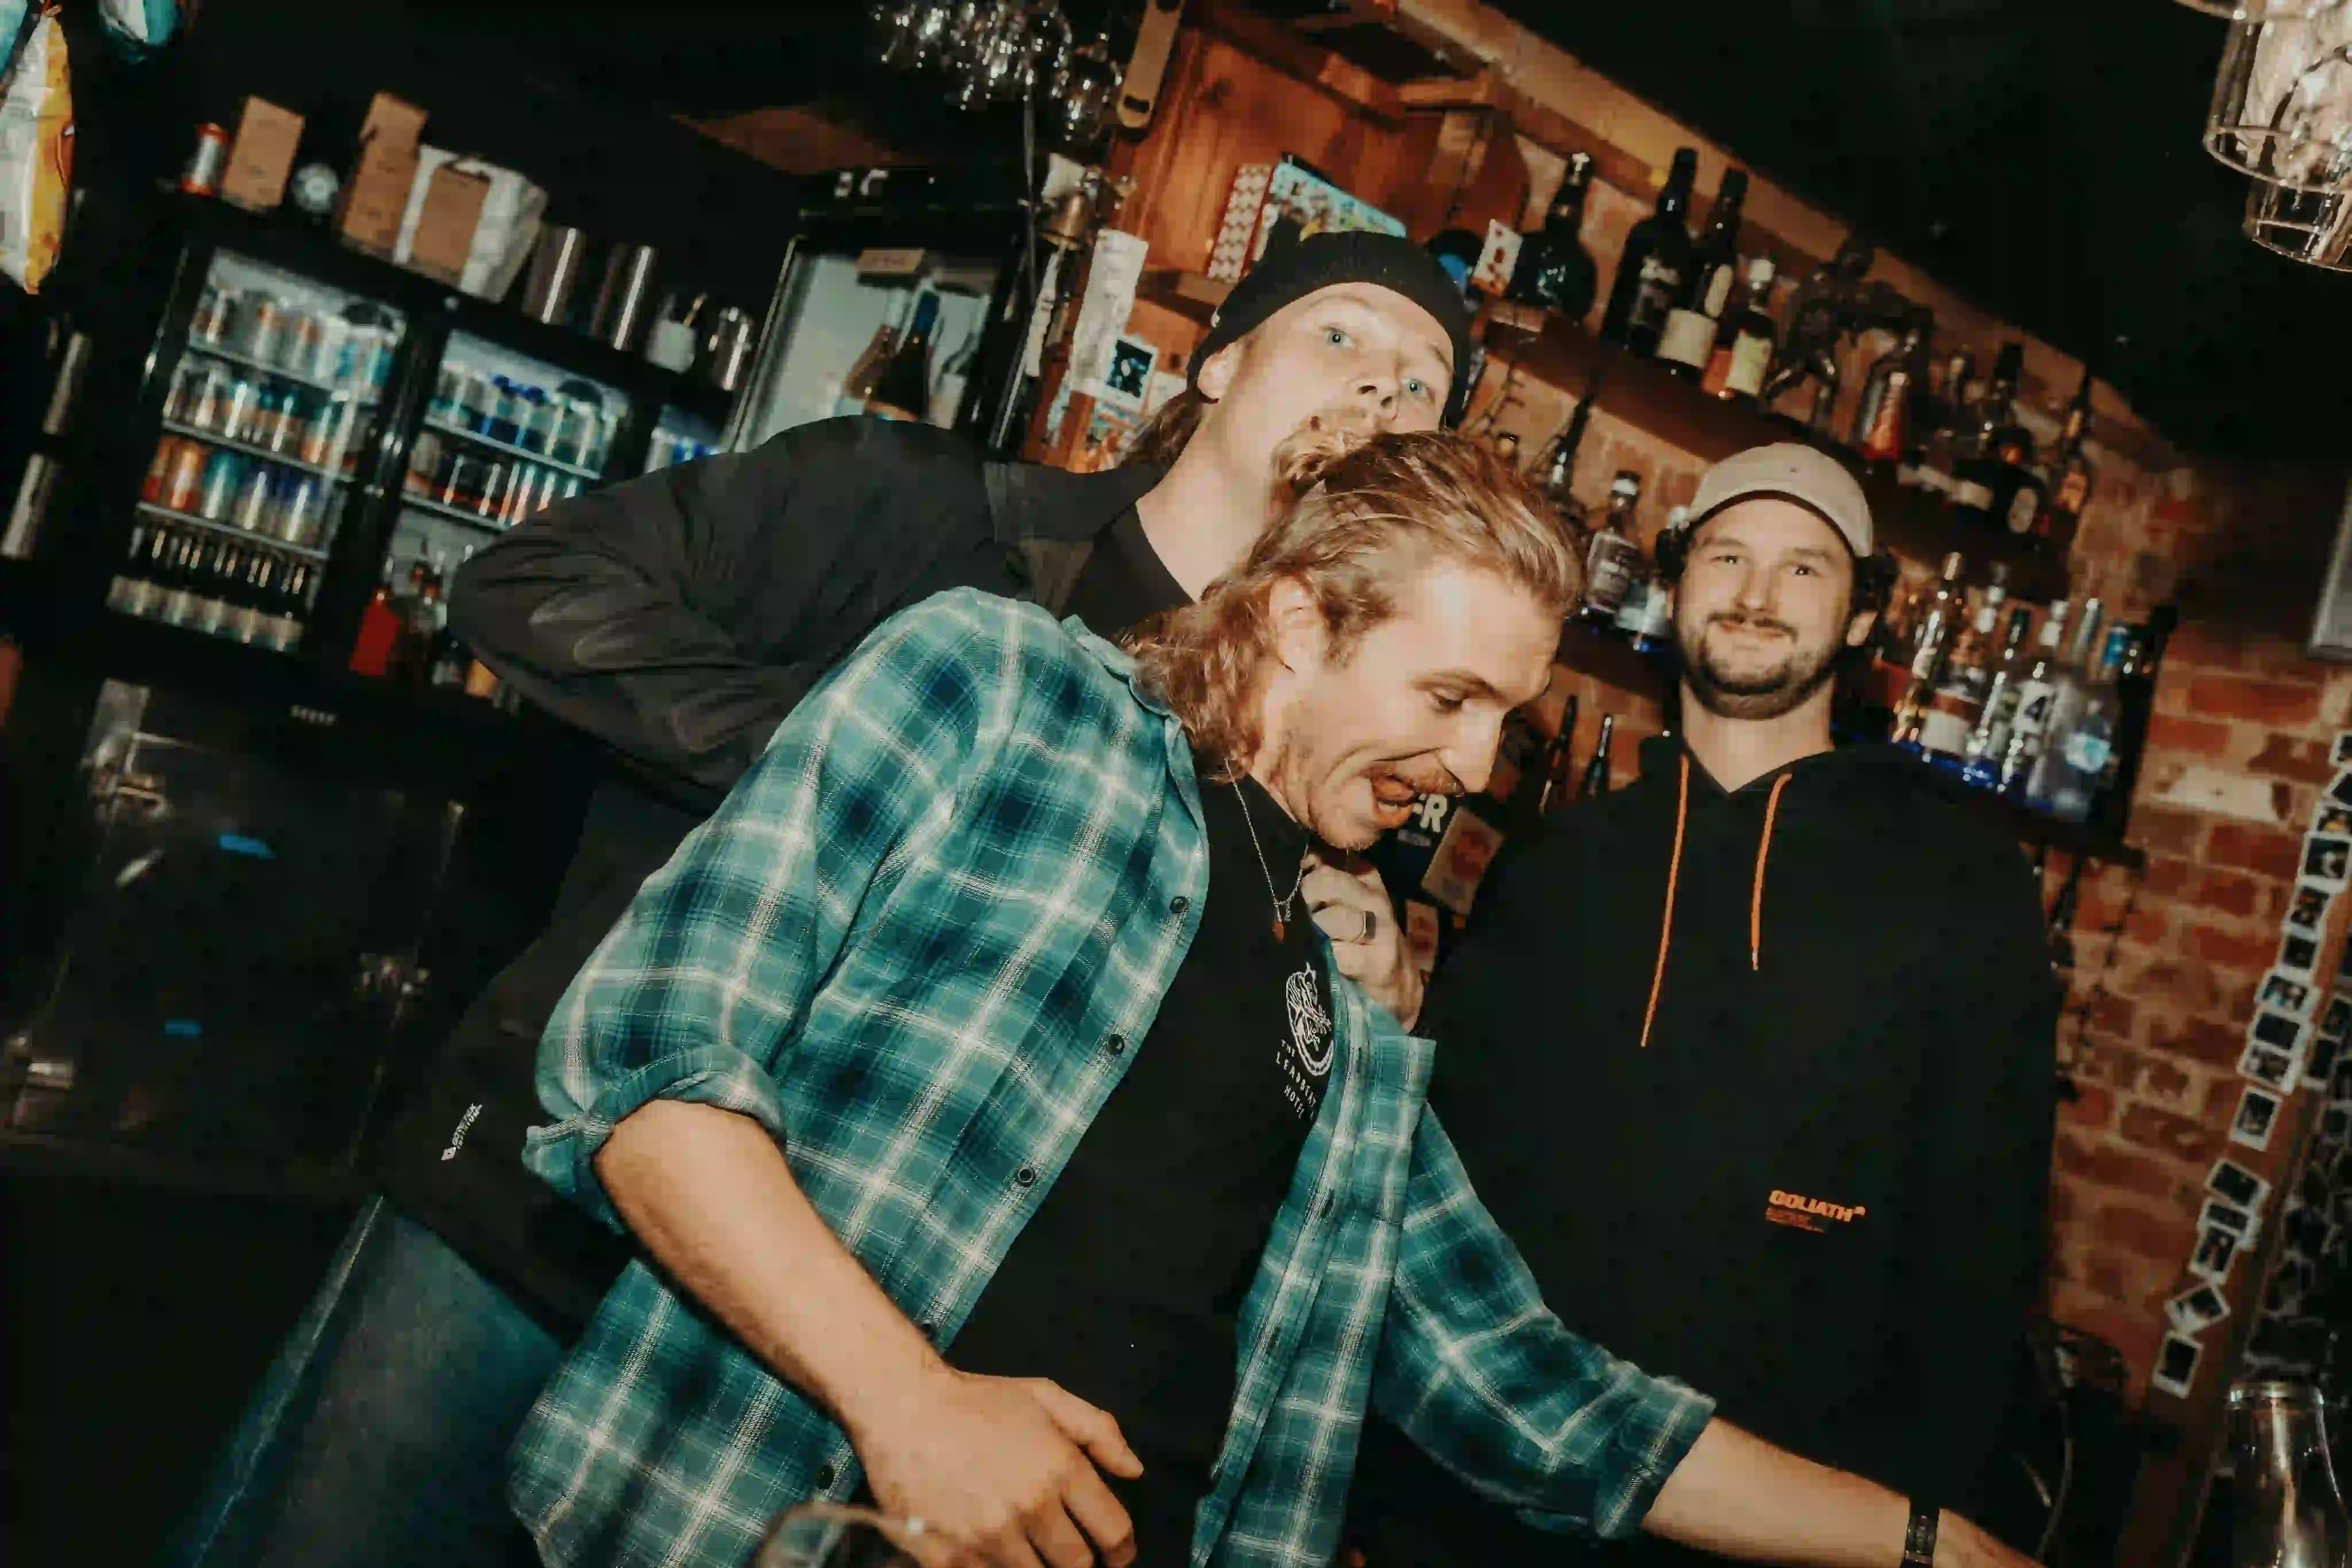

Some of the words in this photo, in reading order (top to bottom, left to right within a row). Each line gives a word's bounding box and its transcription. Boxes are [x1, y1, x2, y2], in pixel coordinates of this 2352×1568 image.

[1281, 1038, 1296, 1058] THE
[1284, 1083, 1305, 1119] HOTEL
[1769, 1190, 1855, 1222] GOLIATH
